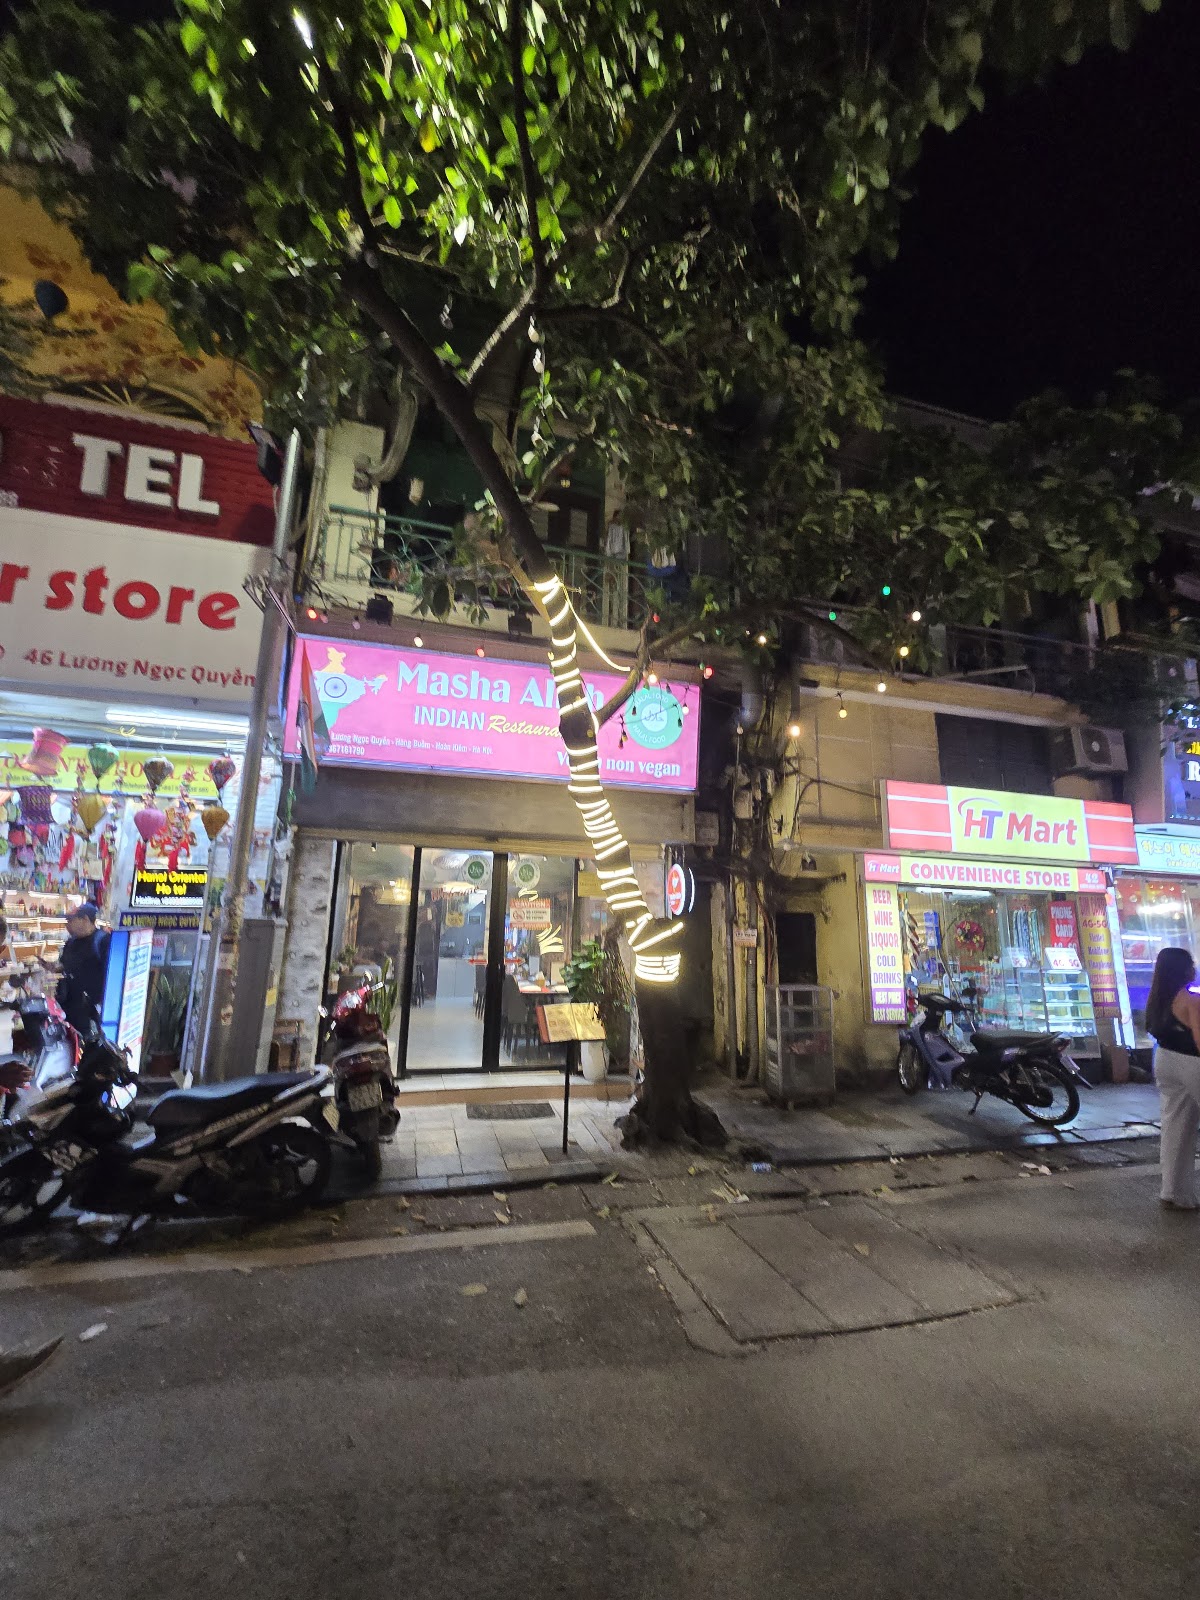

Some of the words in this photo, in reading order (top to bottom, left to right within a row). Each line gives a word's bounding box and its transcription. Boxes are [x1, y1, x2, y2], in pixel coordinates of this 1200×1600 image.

[72, 432, 221, 517] TEL
[45, 565, 240, 630] store
[24, 648, 53, 666] 46
[397, 659, 510, 703] Masha
[519, 675, 605, 712] Alh
[414, 705, 485, 731] INDIAN
[487, 714, 562, 738] Restaura
[606, 758, 635, 773] non
[638, 761, 681, 779] vegan
[962, 806, 1003, 841] HT
[1006, 812, 1078, 846] Mart
[880, 864, 900, 875] Mart
[910, 863, 1021, 885] CONVENIENCE
[1025, 870, 1071, 887] STORE
[872, 889, 892, 905] BEER
[873, 910, 893, 926] WINE
[1050, 906, 1073, 920] PHONE
[1055, 924, 1074, 938] CARD
[870, 932, 899, 951] LIQUOR
[876, 955, 897, 967] COLD
[873, 972, 902, 985] DRINKS
